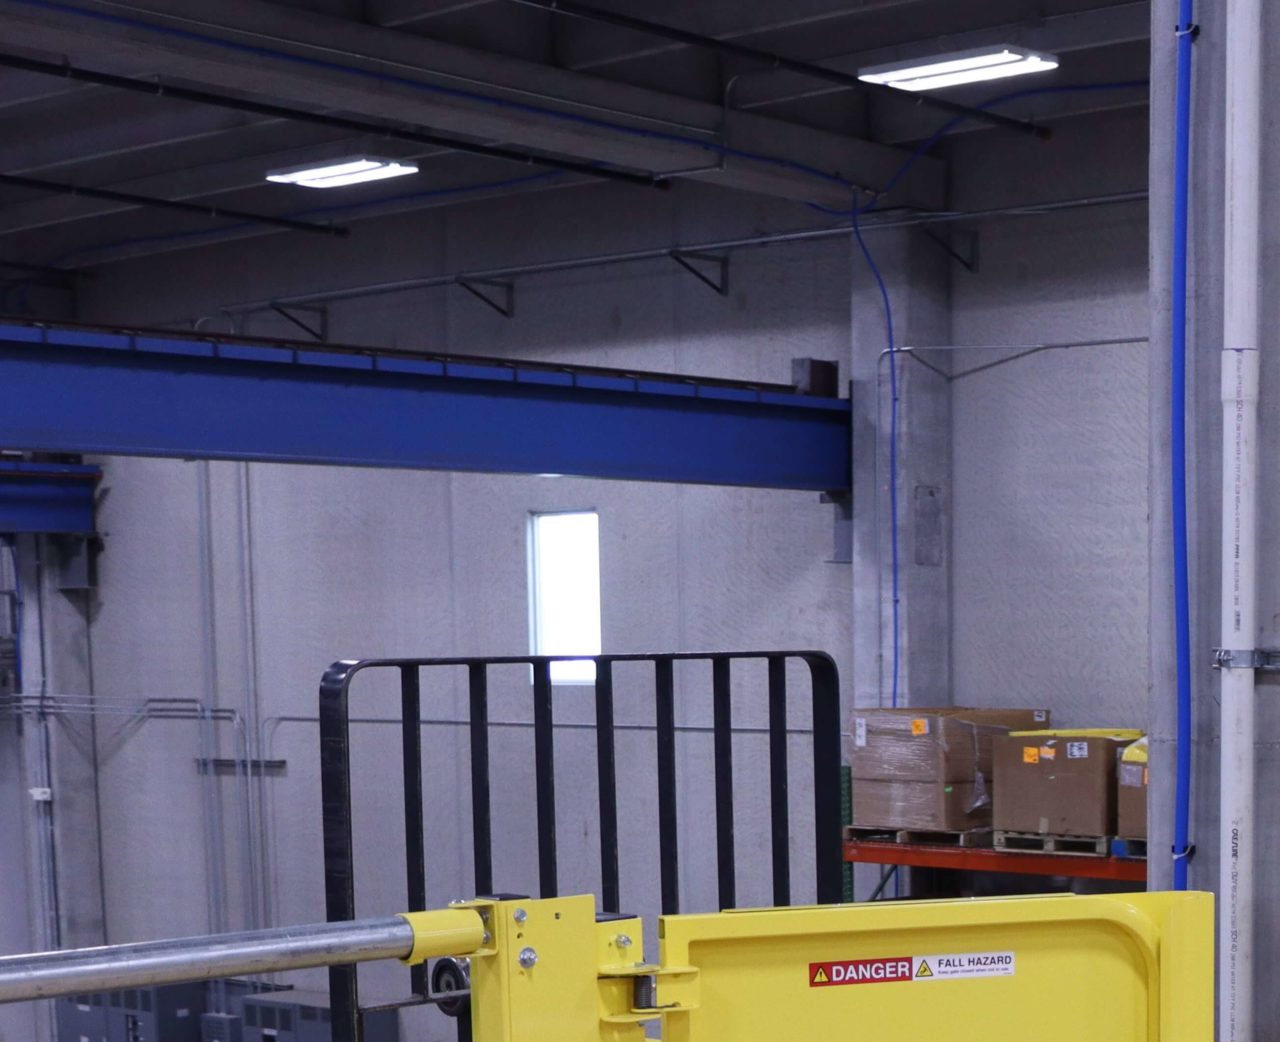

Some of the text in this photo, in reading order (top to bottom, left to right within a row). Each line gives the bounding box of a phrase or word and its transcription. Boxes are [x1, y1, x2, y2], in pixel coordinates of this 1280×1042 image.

[937, 955, 1012, 968] FALL HAZARD
[831, 962, 910, 981] DANGER
